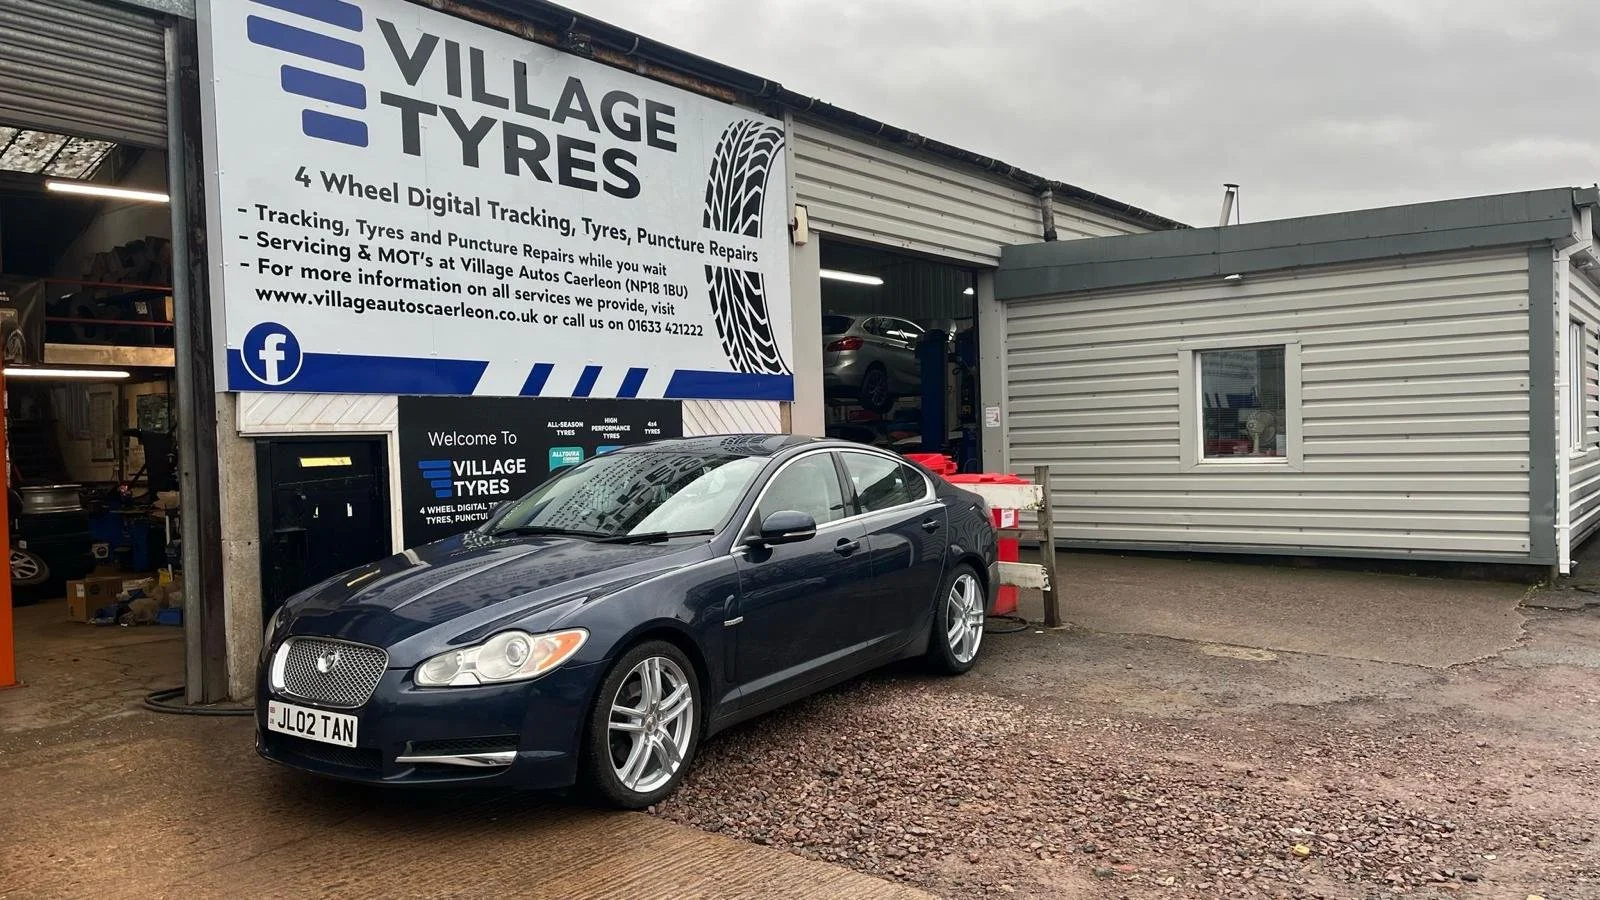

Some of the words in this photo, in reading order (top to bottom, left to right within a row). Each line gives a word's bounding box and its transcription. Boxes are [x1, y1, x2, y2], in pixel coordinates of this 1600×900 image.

[375, 17, 678, 153] VILLAGE
[380, 90, 642, 200] TYRES
[294, 165, 312, 188] 4
[319, 170, 399, 204] Wheel
[407, 186, 481, 217] Digital
[487, 200, 577, 238] Tracking,
[581, 216, 632, 246] Tyres,
[637, 226, 705, 255] Puncture
[709, 239, 759, 263] Repairs
[254, 203, 350, 237] Tracking,
[355, 218, 405, 241] Tyres
[410, 230, 442, 246] and
[447, 232, 518, 256] Puncture
[522, 243, 575, 264] Repairs
[578, 255, 613, 269] while
[616, 260, 639, 274] you
[642, 263, 667, 277] wait
[256, 230, 351, 263] Servicing
[357, 243, 372, 262] &
[378, 246, 434, 268] MOT's
[438, 256, 456, 271] at
[459, 256, 514, 281] Village
[518, 265, 560, 283] Autos
[563, 270, 622, 291] Caerleon
[625, 278, 660, 296] (NP18
[662, 283, 689, 300] 1BU)
[257, 258, 294, 277] For
[300, 266, 352, 284] more
[358, 268, 462, 294] information
[467, 284, 487, 297] on
[491, 283, 510, 299] all
[514, 288, 571, 307] services
[574, 296, 593, 308] we
[597, 297, 648, 316] provide,
[651, 301, 676, 317] visit
[255, 288, 539, 325] www.villageautoscaerleon.co.uk
[543, 314, 559, 326] or
[562, 312, 585, 329] call
[589, 318, 604, 331] us
[607, 320, 624, 332] on
[627, 317, 662, 334] 01633
[664, 321, 704, 337] 421222
[547, 421, 584, 429] ALL-SEASON
[556, 429, 576, 437] TYRES
[591, 424, 631, 432] PERFORMANCE
[428, 431, 497, 448] Welcome
[501, 430, 518, 446] To
[452, 458, 527, 477] VILLAGE
[453, 478, 510, 497] TYRES
[419, 506, 426, 515] 4
[427, 504, 456, 515] WHEEL
[457, 502, 488, 512] DIGITAL
[425, 515, 454, 525] TYRES,
[320, 714, 354, 743] TAN
